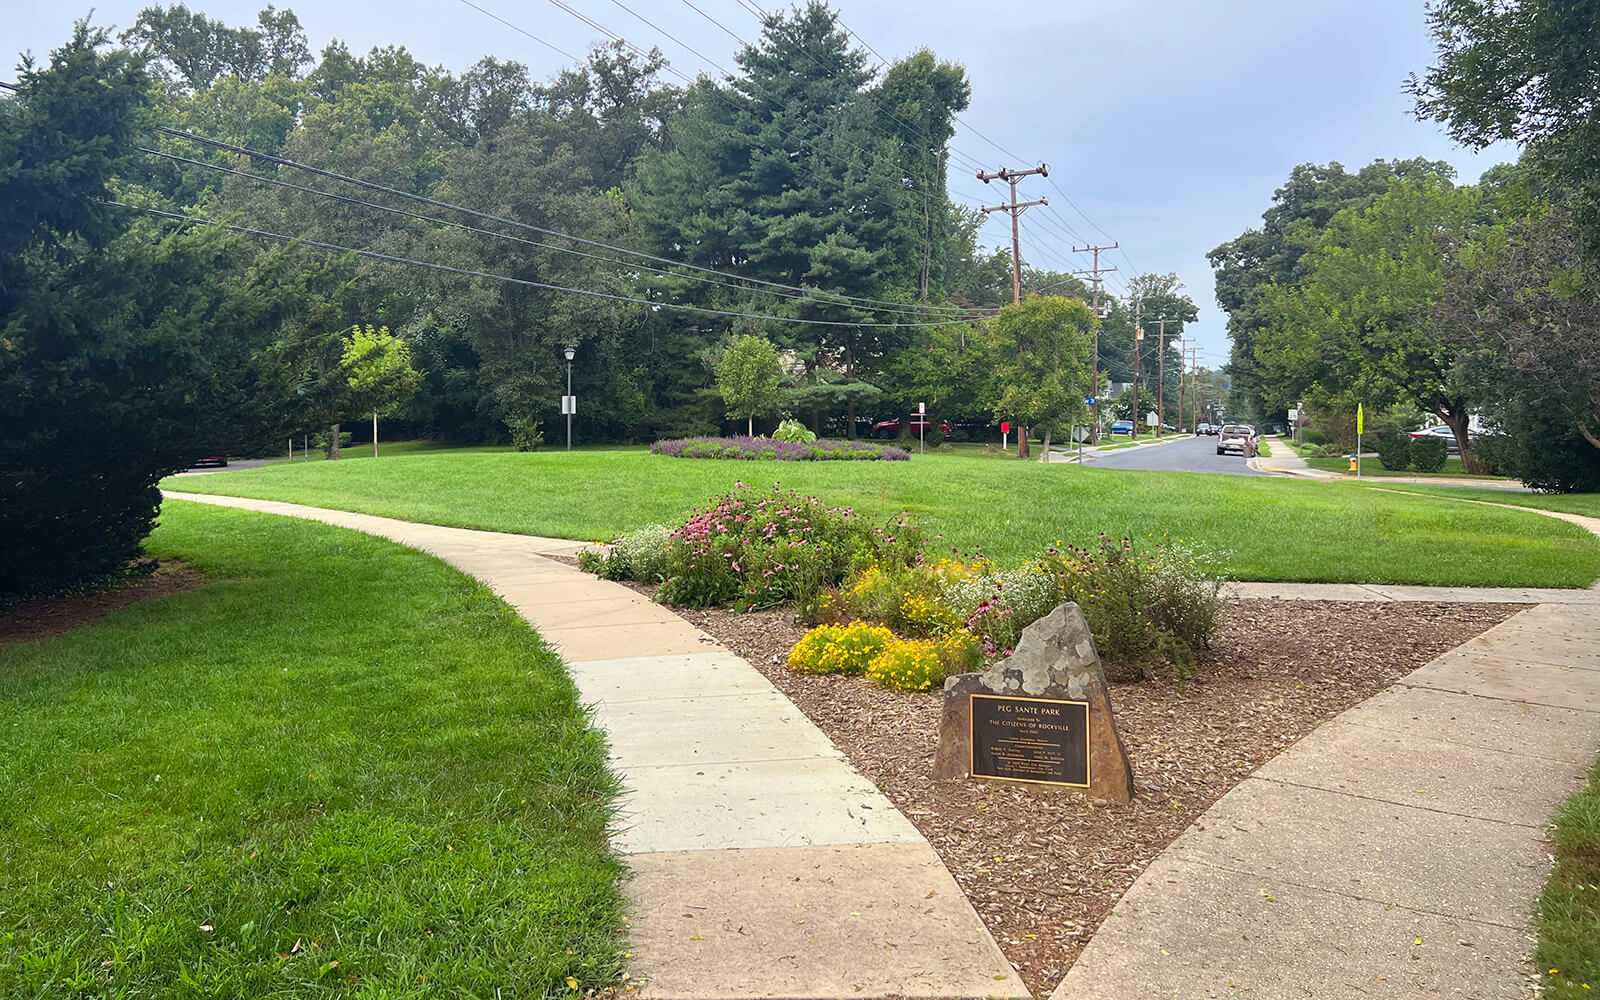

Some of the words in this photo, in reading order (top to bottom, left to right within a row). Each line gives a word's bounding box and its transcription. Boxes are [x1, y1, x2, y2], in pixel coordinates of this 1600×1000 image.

[998, 705, 1012, 713] PEG
[1015, 706, 1038, 715] SANTE
[1041, 708, 1060, 716] PARK
[1039, 723, 1069, 731] ROCKVILLE
